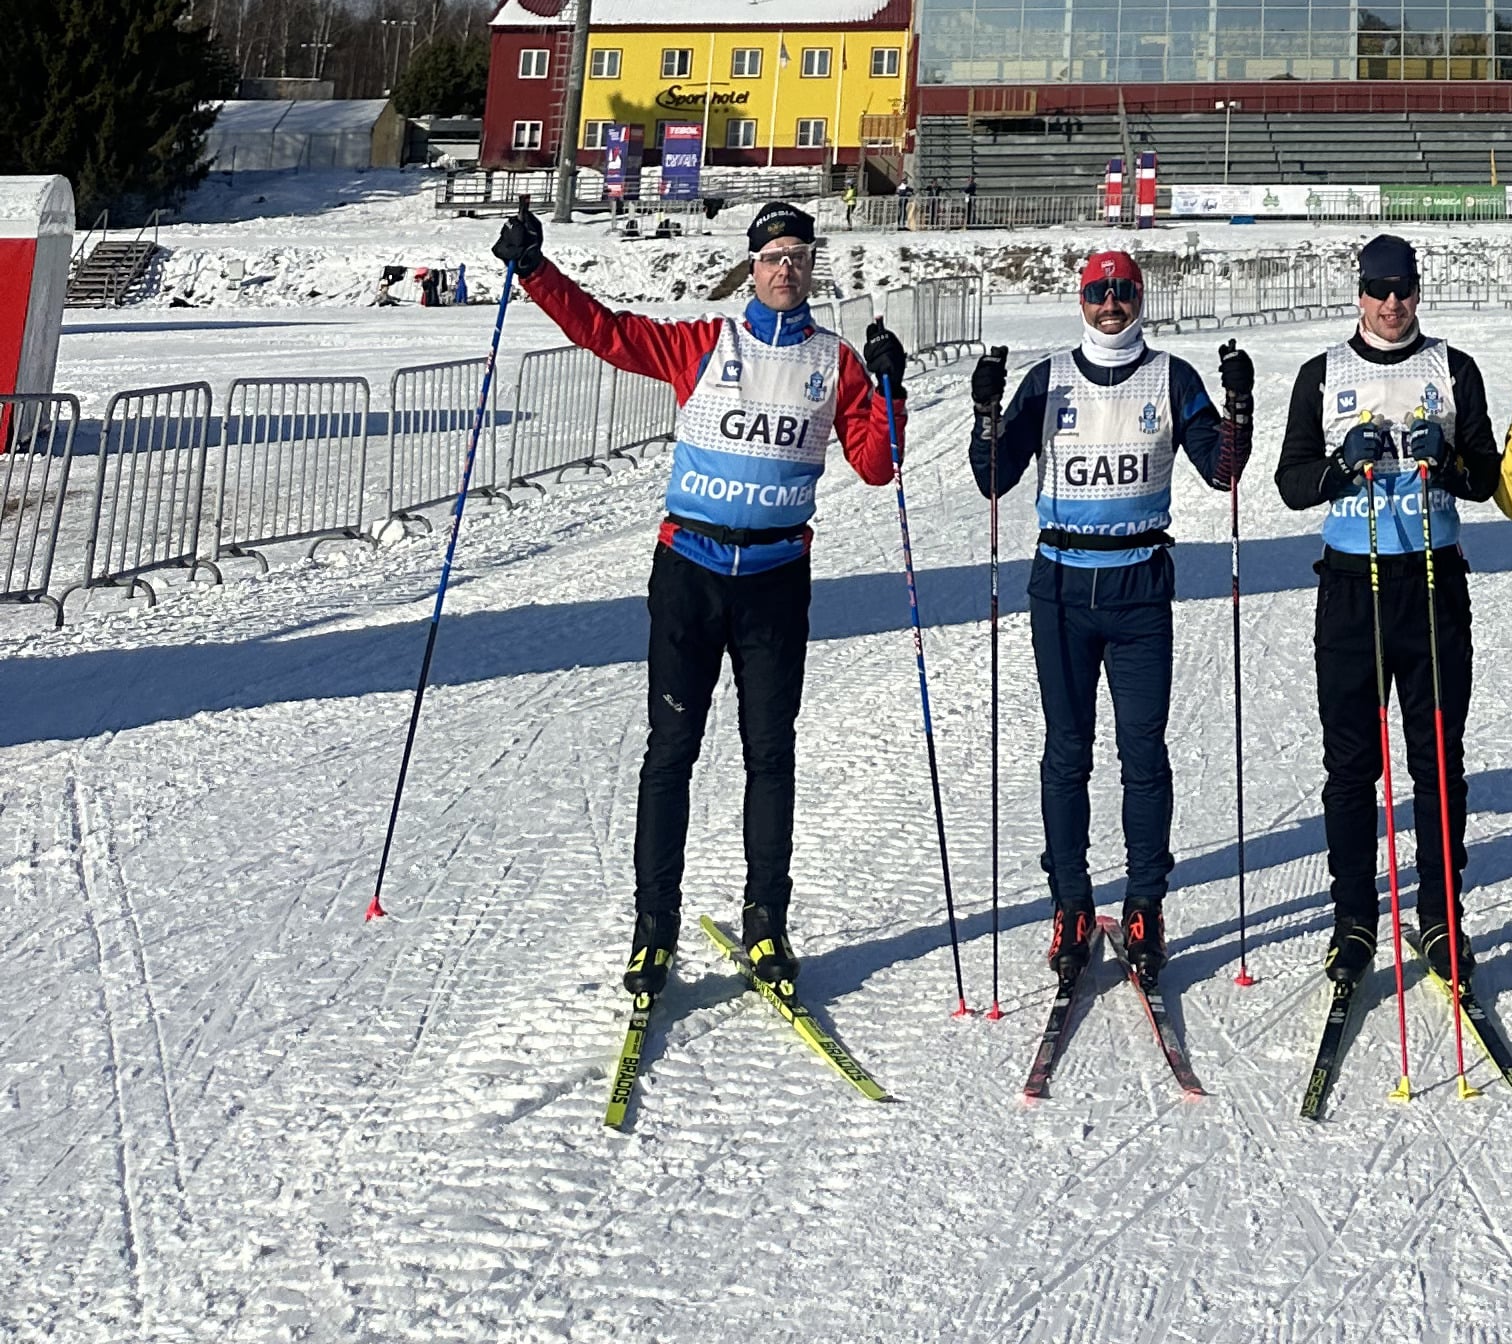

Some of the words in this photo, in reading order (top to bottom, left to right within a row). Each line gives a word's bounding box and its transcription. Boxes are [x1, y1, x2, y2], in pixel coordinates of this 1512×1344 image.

[755, 210, 798, 228] RUSSIA
[719, 409, 810, 449] GABI
[1064, 453, 1149, 486] GABI
[611, 1057, 639, 1105] BRADOS
[820, 1041, 868, 1082] BRADOS
